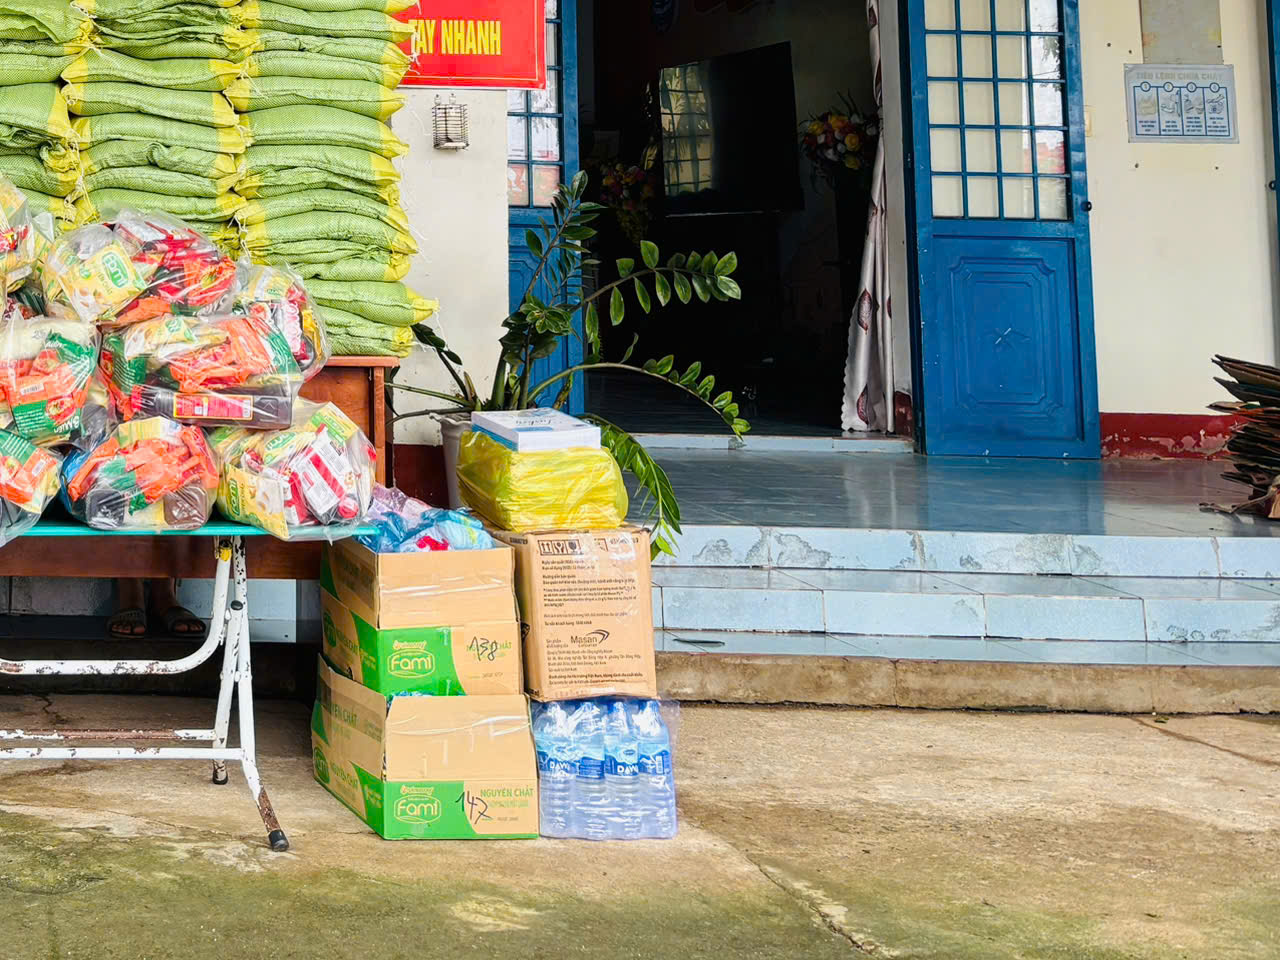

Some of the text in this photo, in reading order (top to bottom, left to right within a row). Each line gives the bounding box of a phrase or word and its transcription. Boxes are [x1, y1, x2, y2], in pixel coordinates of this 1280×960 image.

[408, 20, 501, 55] TAY NHANH
[570, 636, 598, 644] Masan
